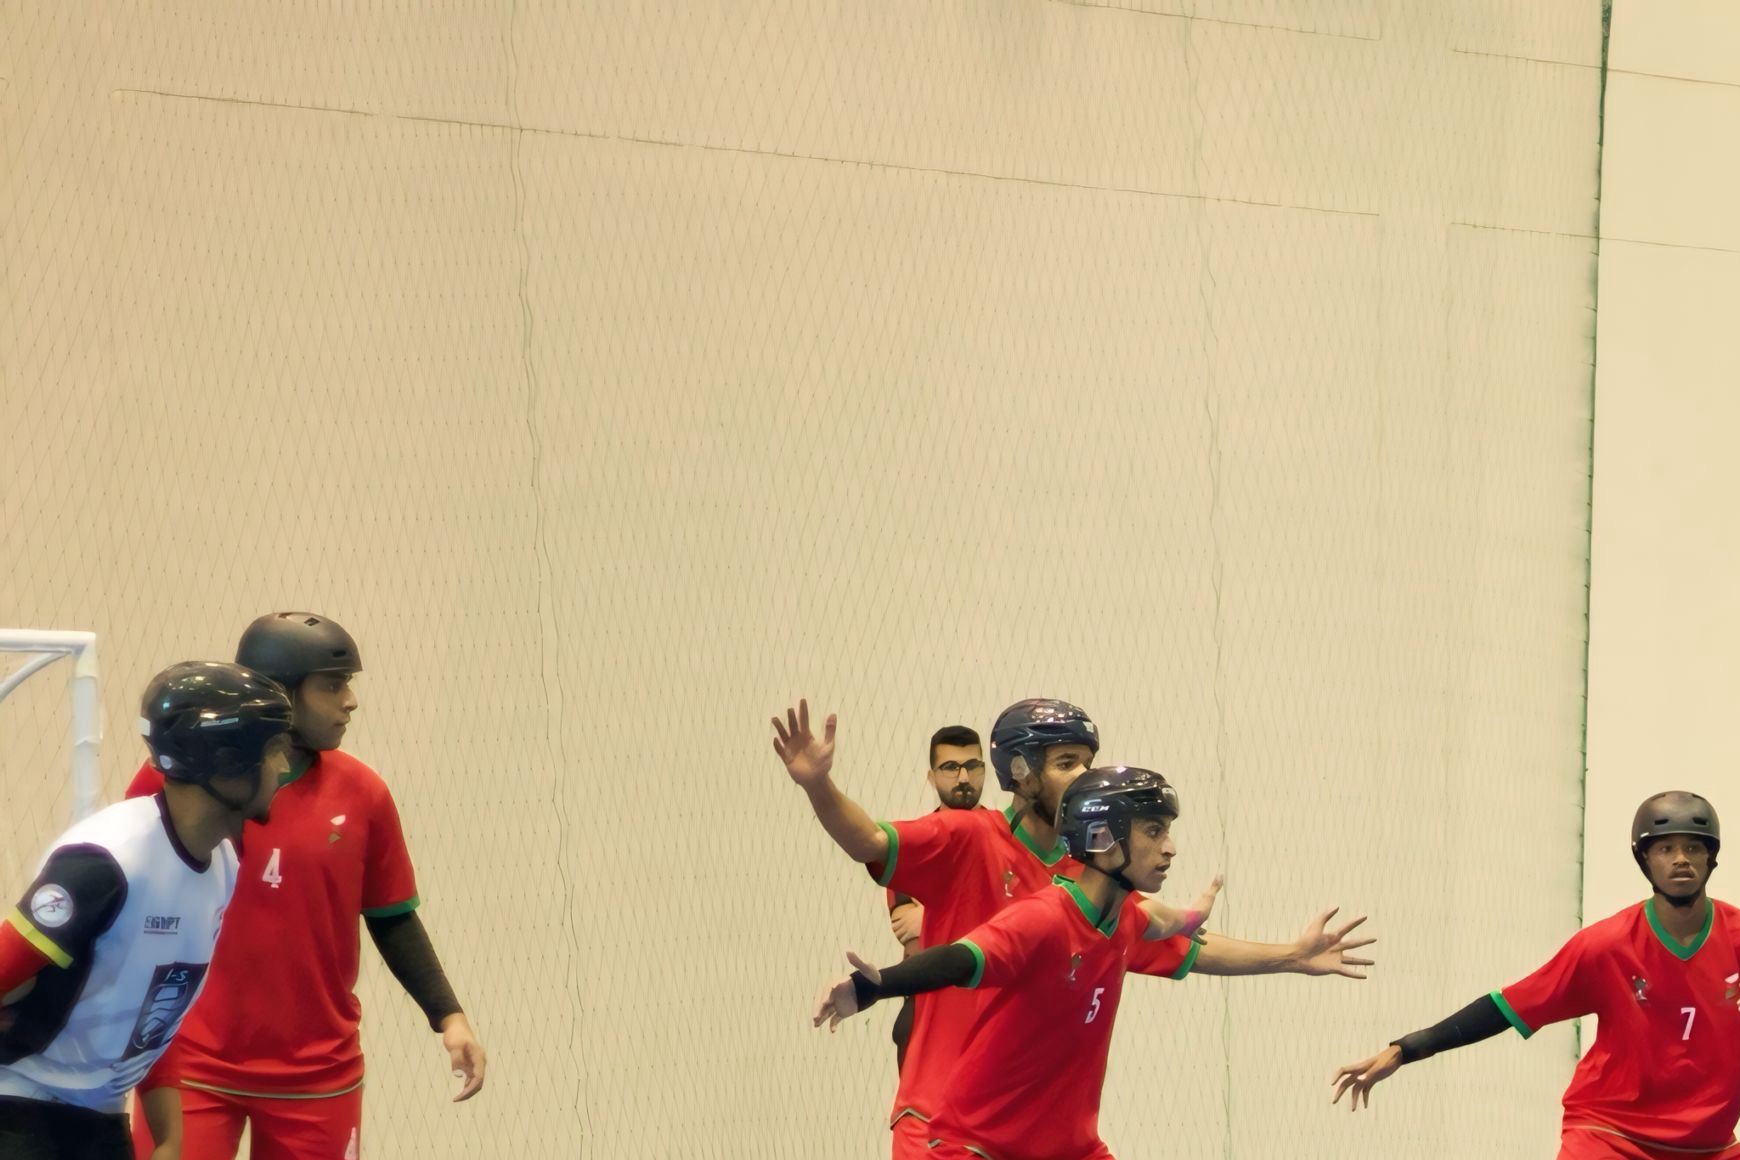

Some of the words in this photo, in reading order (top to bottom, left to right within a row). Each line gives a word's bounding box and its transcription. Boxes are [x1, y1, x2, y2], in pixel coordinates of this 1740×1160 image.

[261, 847, 283, 889] 4
[143, 915, 182, 930] EGYPT
[1083, 986, 1105, 1024] 5
[1680, 1006, 1696, 1041] 7
